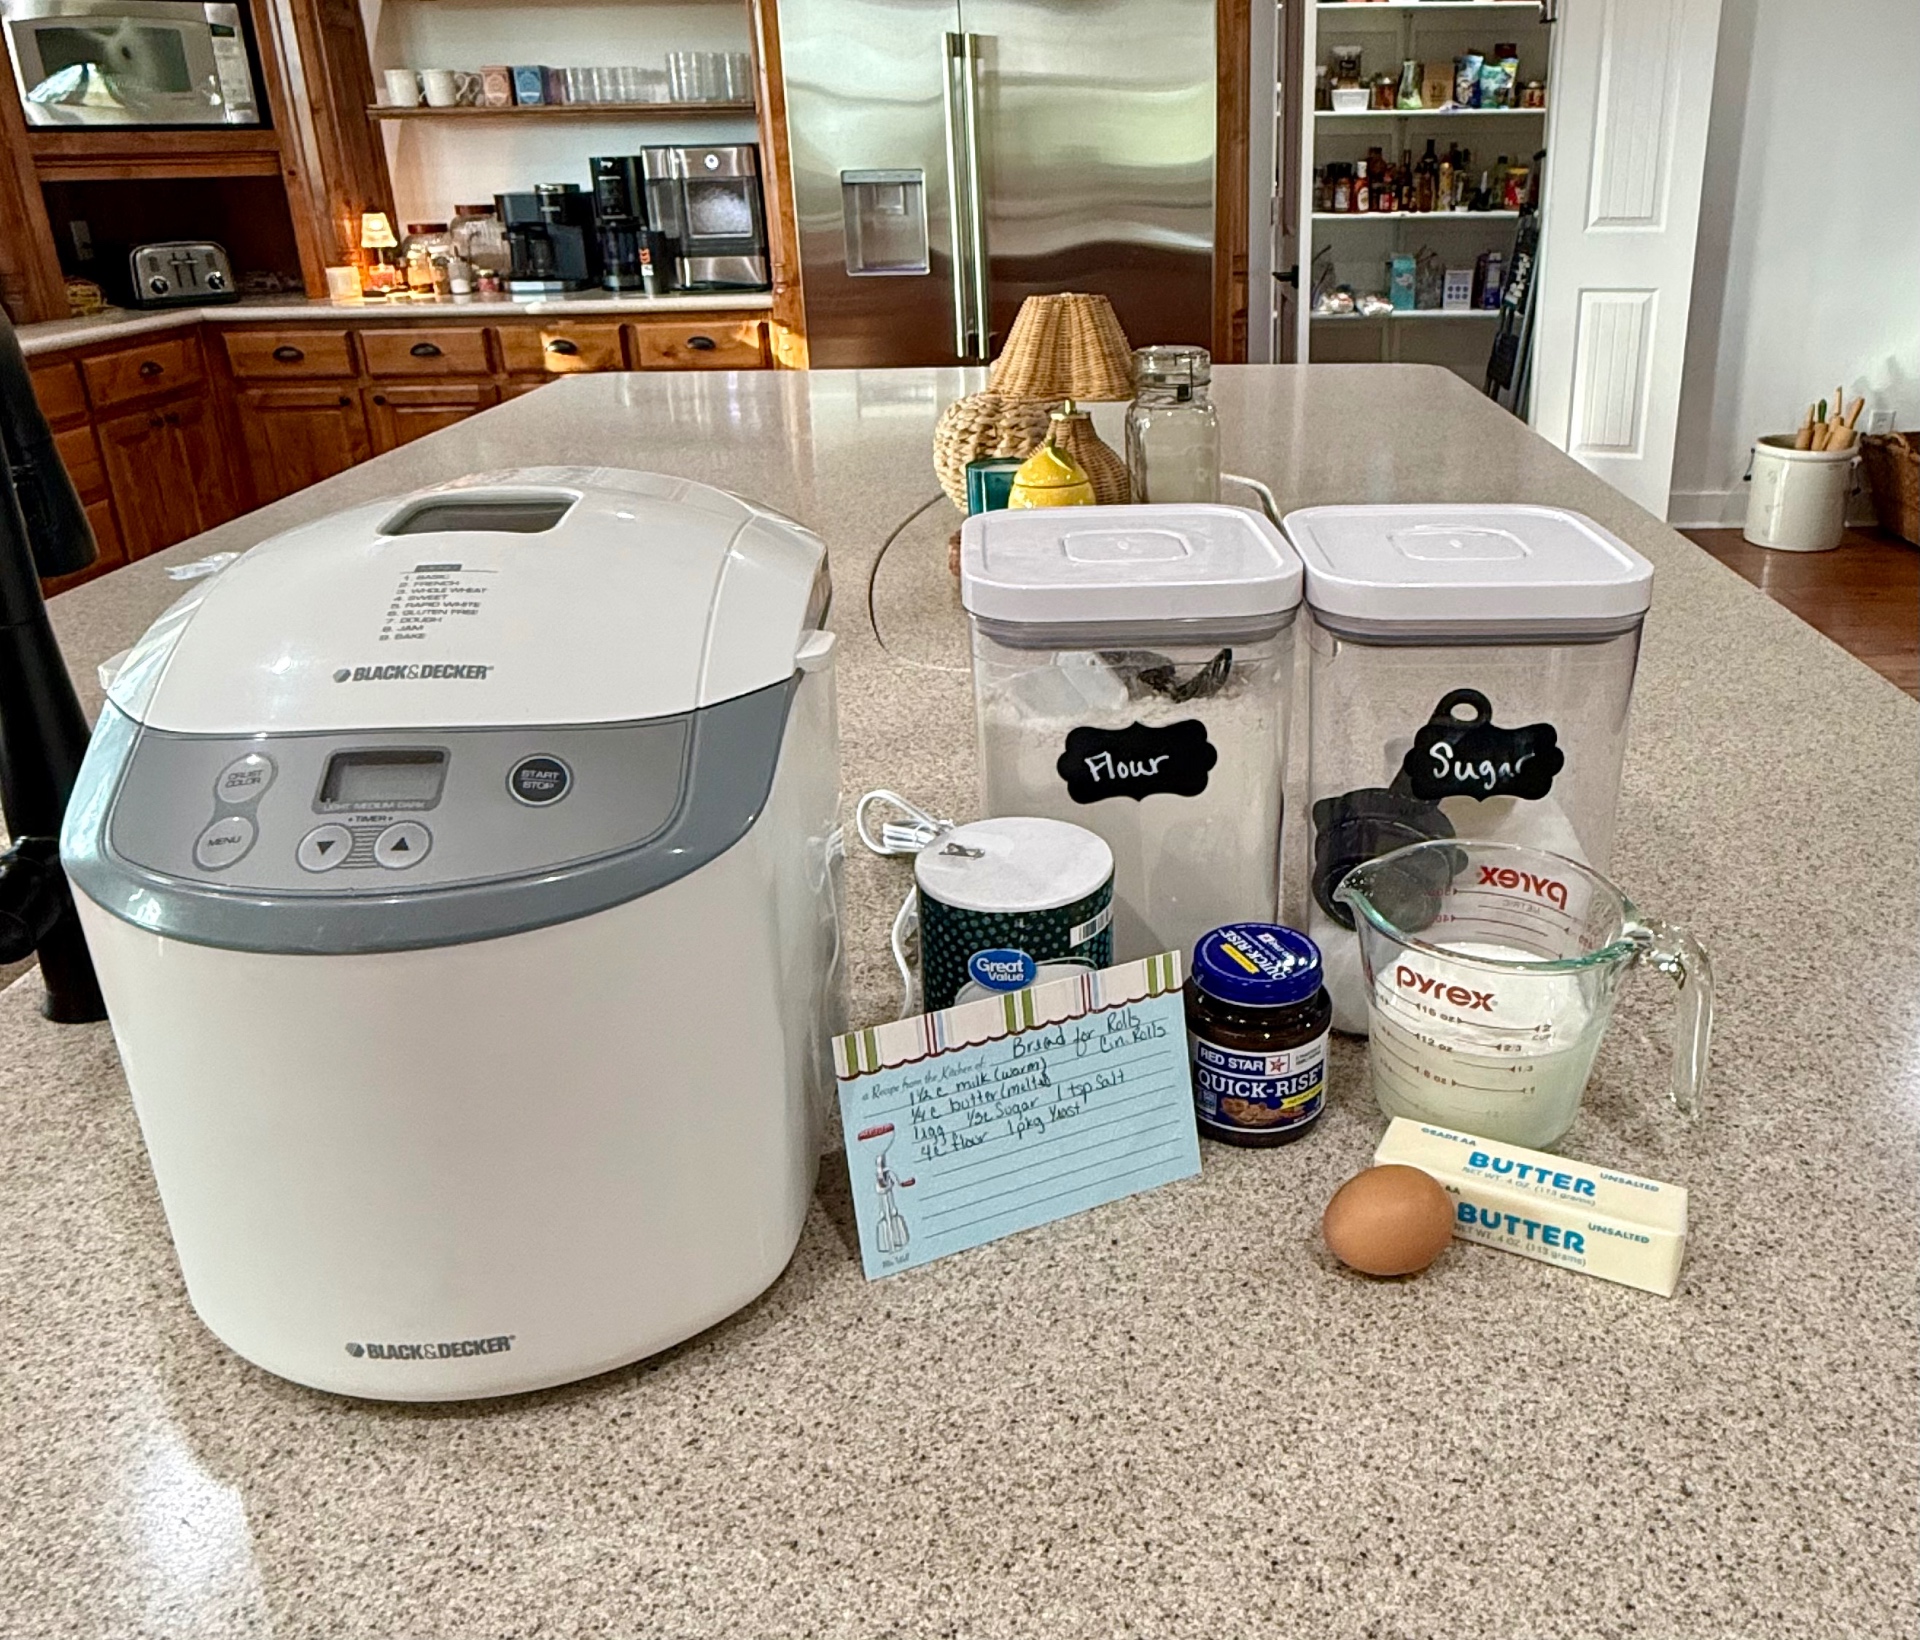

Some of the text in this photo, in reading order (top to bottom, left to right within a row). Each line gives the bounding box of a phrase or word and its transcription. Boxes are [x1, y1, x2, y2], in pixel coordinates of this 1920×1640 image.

[352, 664, 488, 681] BLACK&DECKER
[521, 770, 560, 780] START
[1084, 751, 1170, 782] Flour
[1429, 742, 1535, 790] Sugar
[225, 777, 261, 788] COLOR
[523, 781, 554, 790] STOP
[207, 835, 242, 847] MENU
[976, 957, 1024, 973] Great
[988, 970, 1024, 982] Value
[1397, 965, 1495, 1012] pyrex
[1422, 1006, 1437, 1017] 16
[1012, 1007, 1141, 1059] Bread for Rolls
[1132, 1022, 1167, 1044] Rolls
[1421, 1035, 1435, 1047] 12
[1200, 1047, 1264, 1072] RED STAR
[872, 1084, 899, 1099] Recipe
[902, 1078, 922, 1092] from
[924, 1070, 937, 1082] the
[940, 1064, 972, 1080] Kitchen
[956, 1074, 992, 1093] milk
[994, 1057, 1047, 1080] (warm)
[1198, 1068, 1319, 1098] QUICK-RISE
[949, 1090, 998, 1113] butter
[1068, 1082, 1092, 1104] tsp
[952, 1131, 988, 1152] flour
[1421, 1127, 1477, 1147] GRADE AA
[1462, 1166, 1481, 1178] NET
[1468, 1151, 1596, 1197] BUTTER
[1600, 1172, 1660, 1193] UNSALTED
[1457, 1201, 1585, 1255] BUTTER
[1588, 1222, 1650, 1245] UNSALTED
[1454, 1222, 1475, 1236] NET
[1550, 1248, 1587, 1267] grams)
[366, 1336, 511, 1360] BLACK&DECKER
